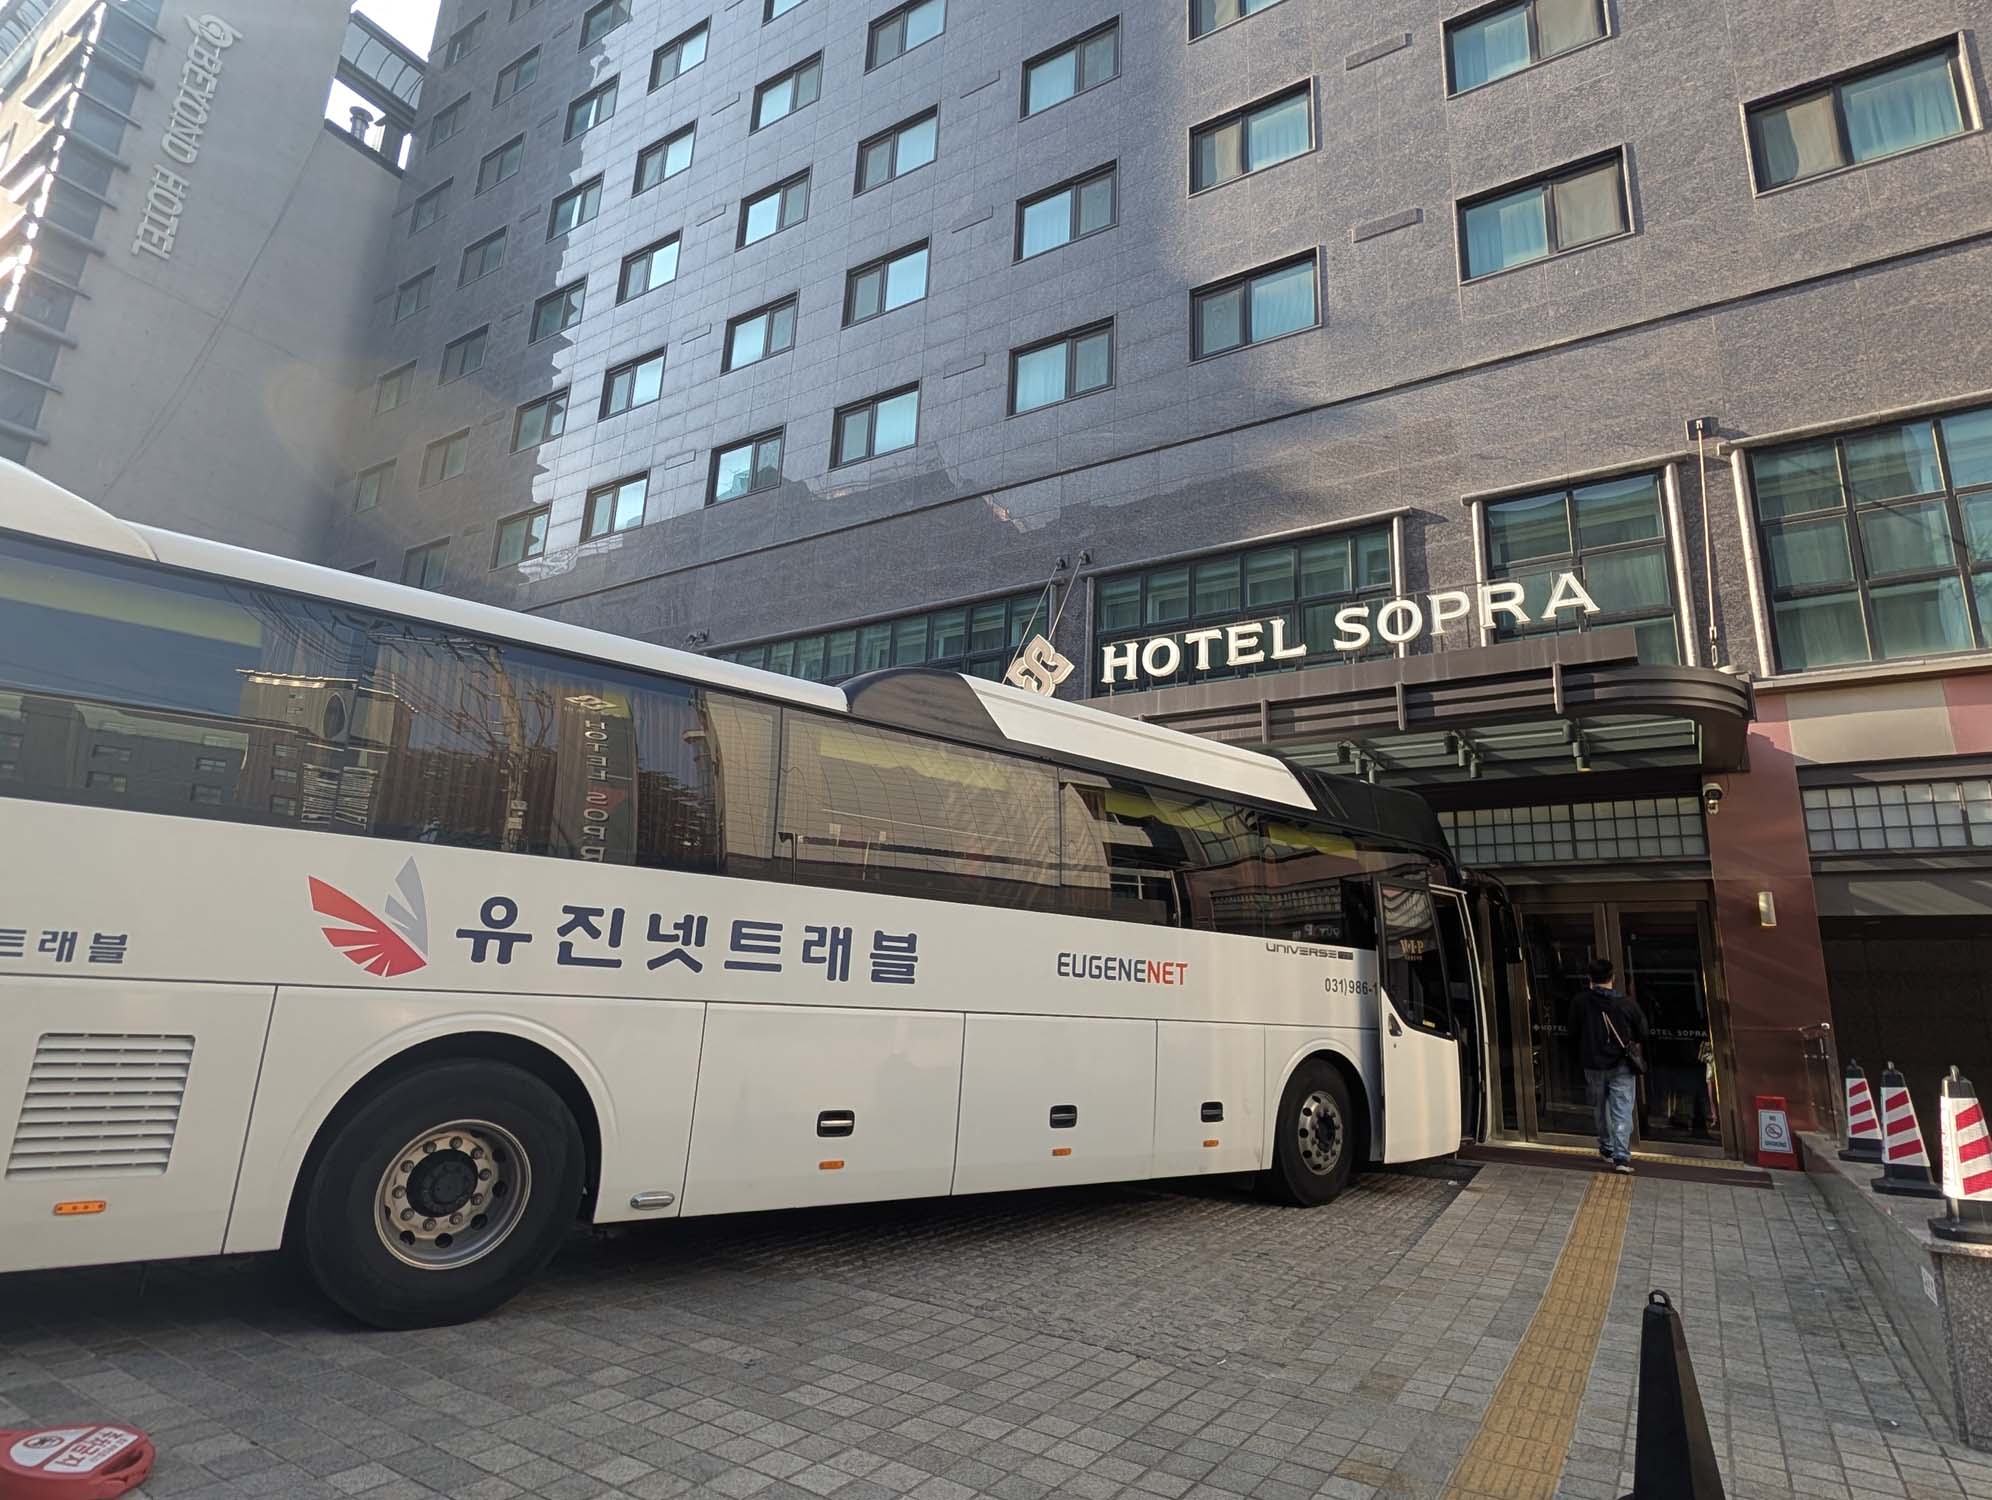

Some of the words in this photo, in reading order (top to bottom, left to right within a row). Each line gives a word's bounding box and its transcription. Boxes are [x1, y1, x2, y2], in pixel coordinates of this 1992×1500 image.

[161, 36, 223, 164] BEYOND
[131, 164, 191, 260] HOTEL
[1101, 618, 1307, 683] HOTEL
[1332, 572, 1600, 651] SOPRA
[456, 896, 918, 985] 유진넷트래블
[1057, 952, 1188, 985] EUGENENET
[1266, 942, 1337, 959] UNIVERSE
[1648, 1028, 1673, 1037] OTEL
[1676, 1029, 1707, 1037] SOPRA
